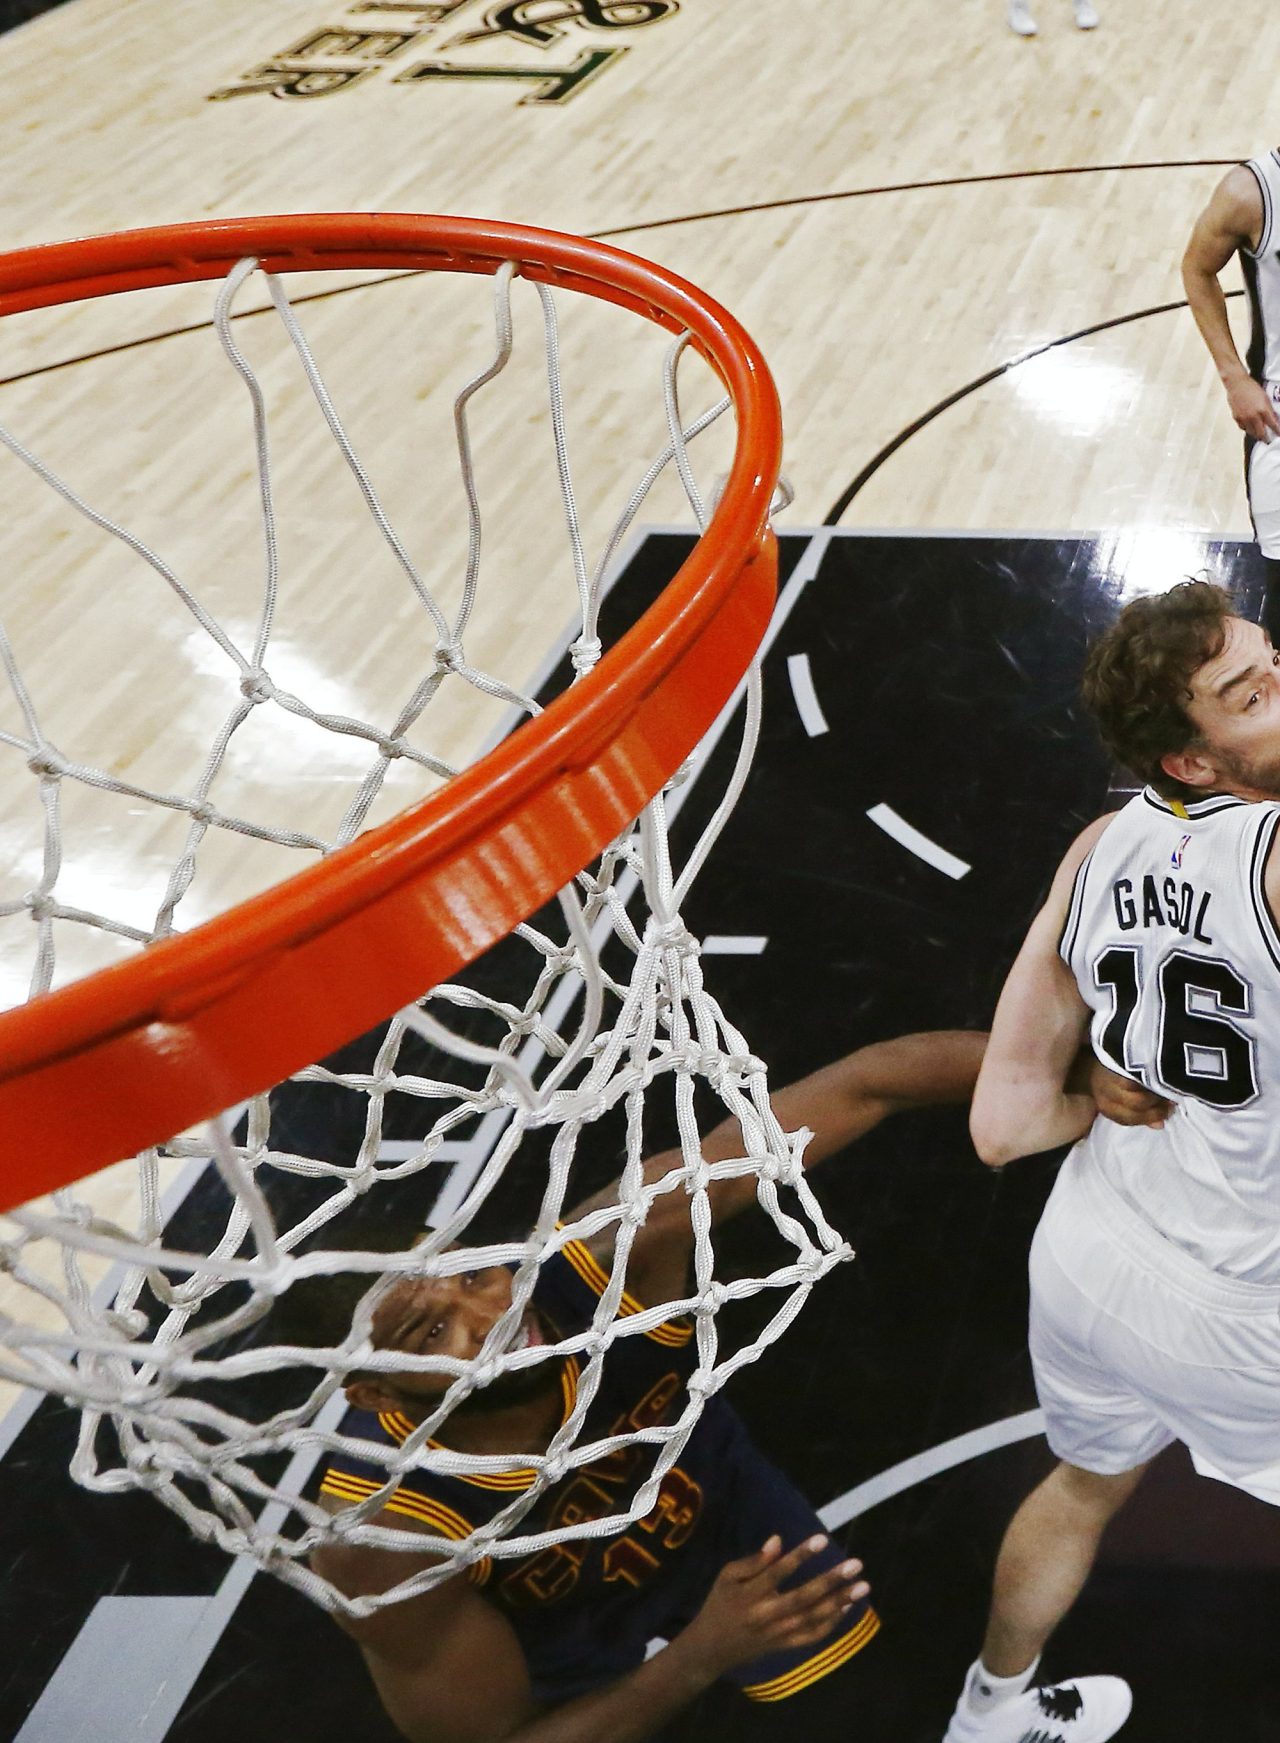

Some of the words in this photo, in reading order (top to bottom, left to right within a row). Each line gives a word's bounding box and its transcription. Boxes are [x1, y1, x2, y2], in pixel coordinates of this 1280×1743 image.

[1112, 874, 1213, 946] GASOL
[1092, 944, 1261, 1113] 16
[602, 1466, 704, 1588] 13
